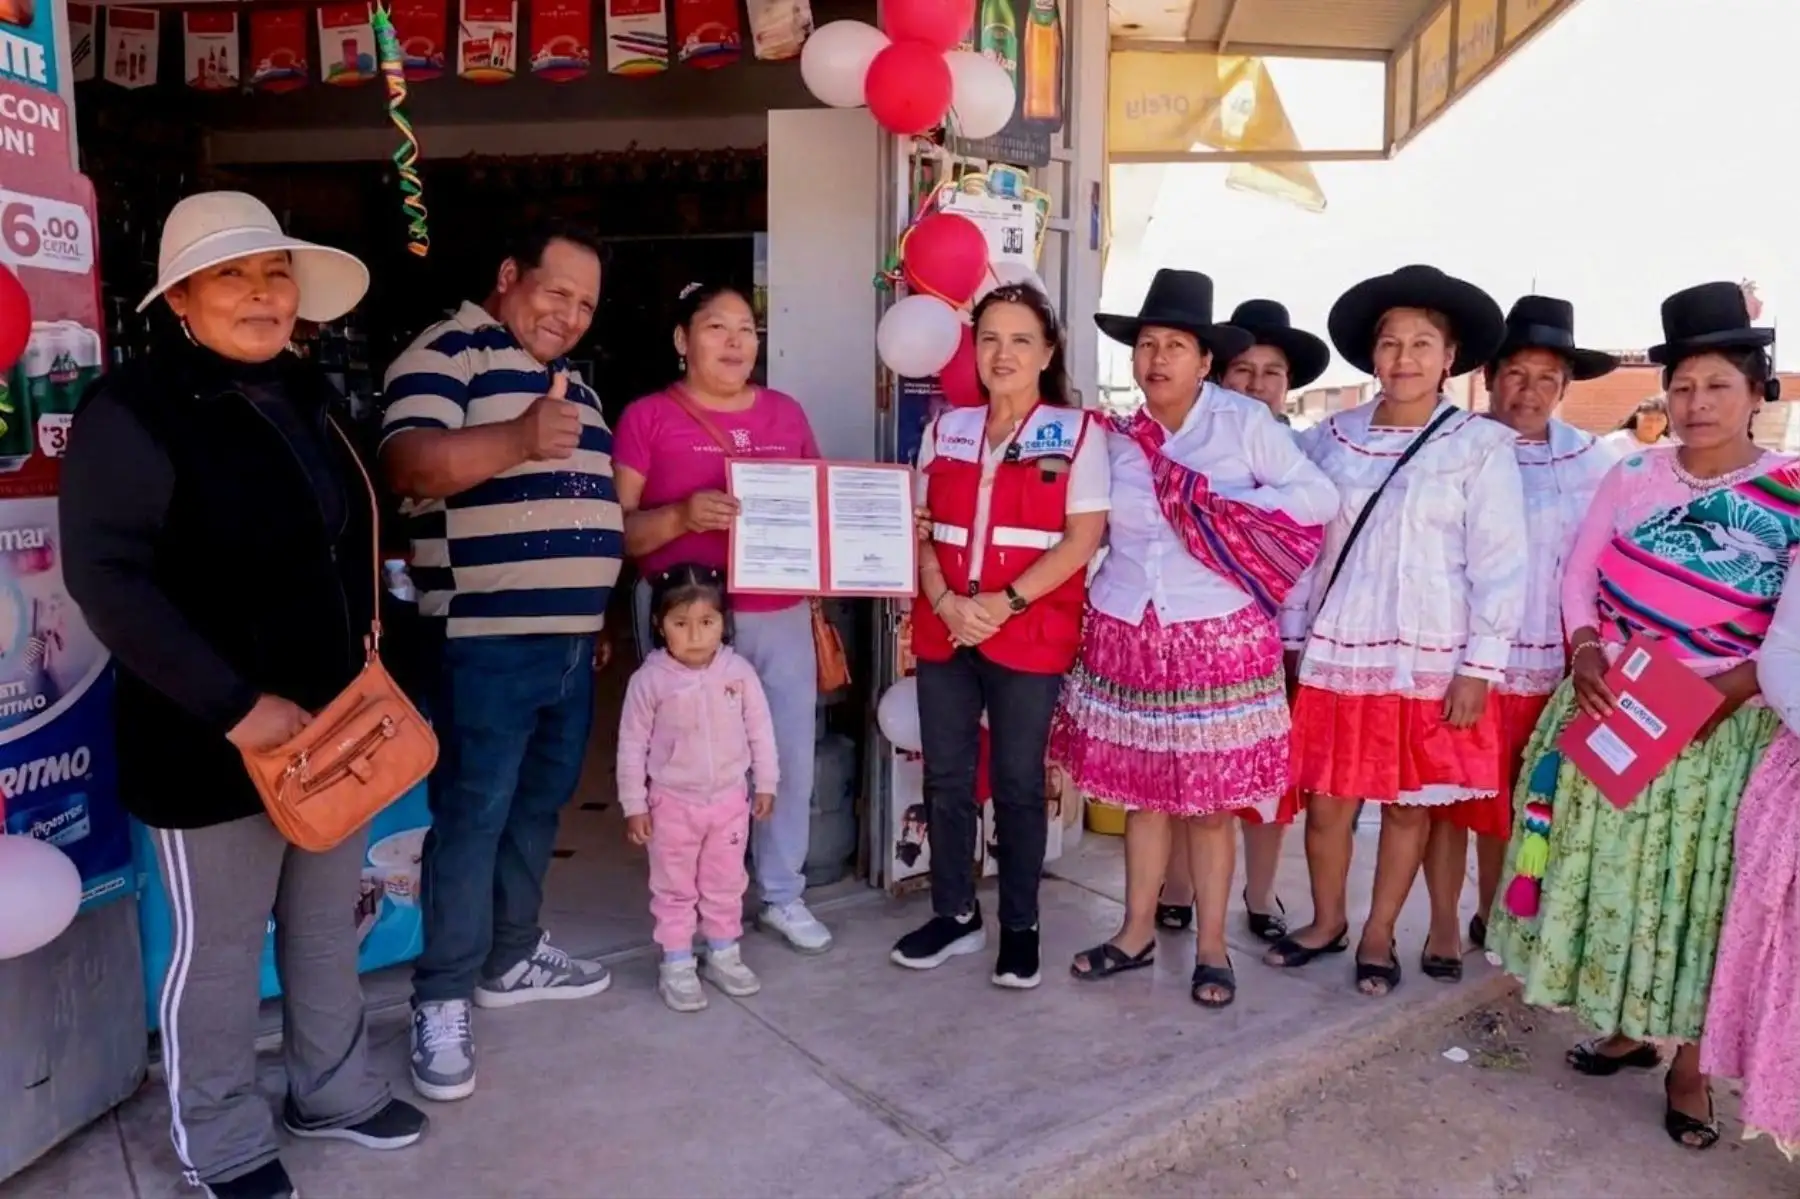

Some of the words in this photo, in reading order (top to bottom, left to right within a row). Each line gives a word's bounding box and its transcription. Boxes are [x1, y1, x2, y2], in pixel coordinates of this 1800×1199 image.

[0, 125, 35, 157] N!
[1, 202, 79, 258] 6.00
[0, 694, 47, 717] ITMO
